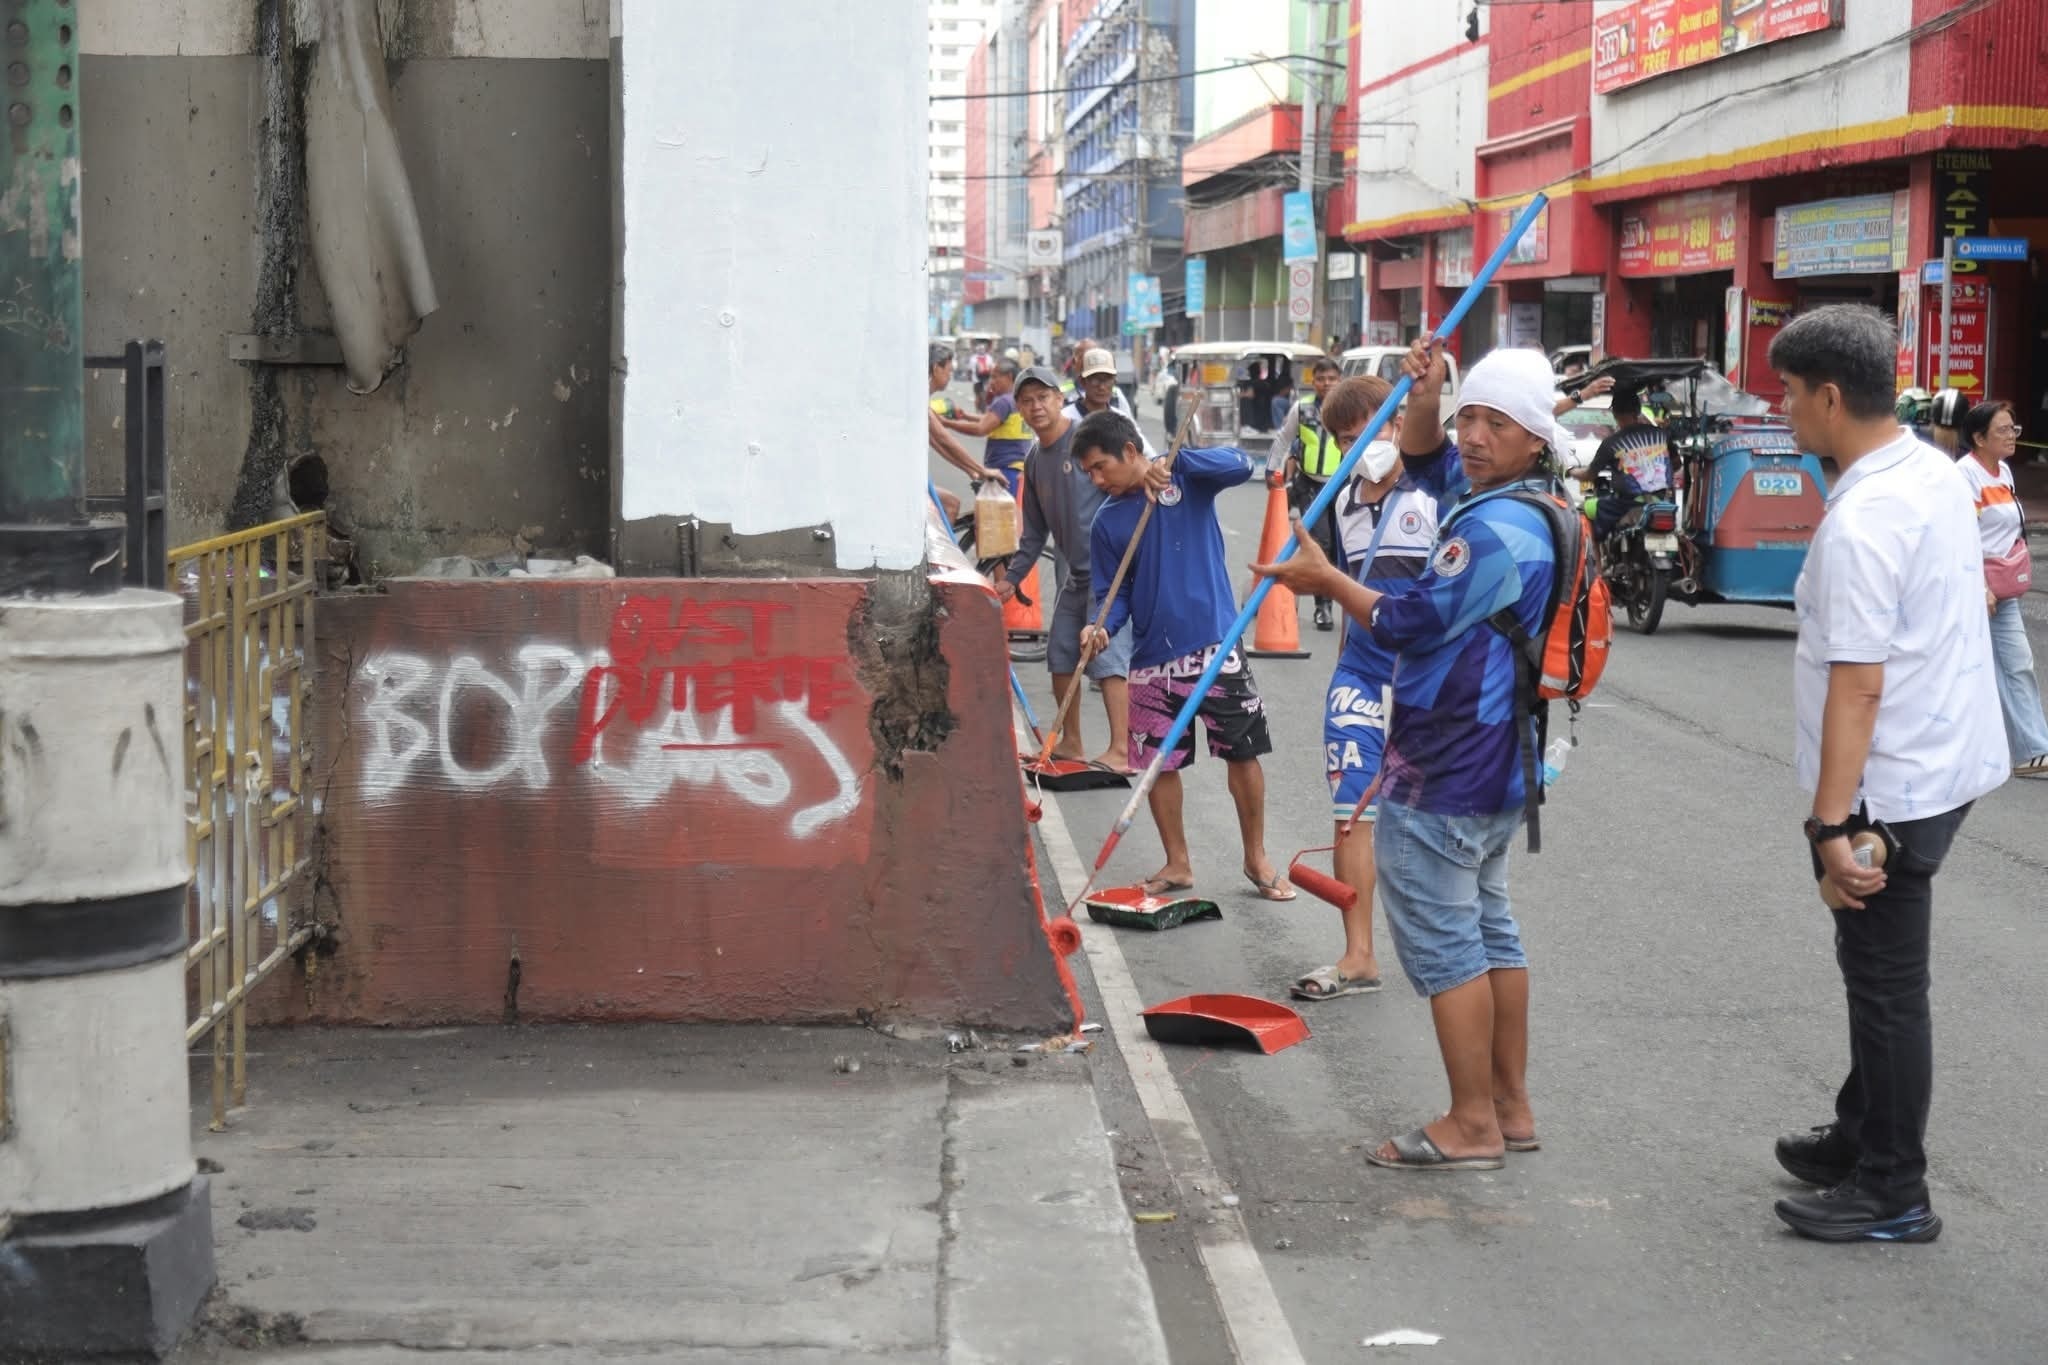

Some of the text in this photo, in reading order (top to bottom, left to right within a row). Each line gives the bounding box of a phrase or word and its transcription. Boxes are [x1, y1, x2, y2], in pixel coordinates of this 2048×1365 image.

[1936, 152, 1992, 170] ETERNAL
[1945, 171, 1979, 272] TATTO
[1960, 314, 1977, 325] WAY
[1952, 329, 1963, 341] TO
[1931, 343, 1984, 356] MOORCYCLE
[1940, 358, 1975, 370] RKING
[1758, 478, 1798, 490] 020
[1324, 740, 1364, 773] SA
